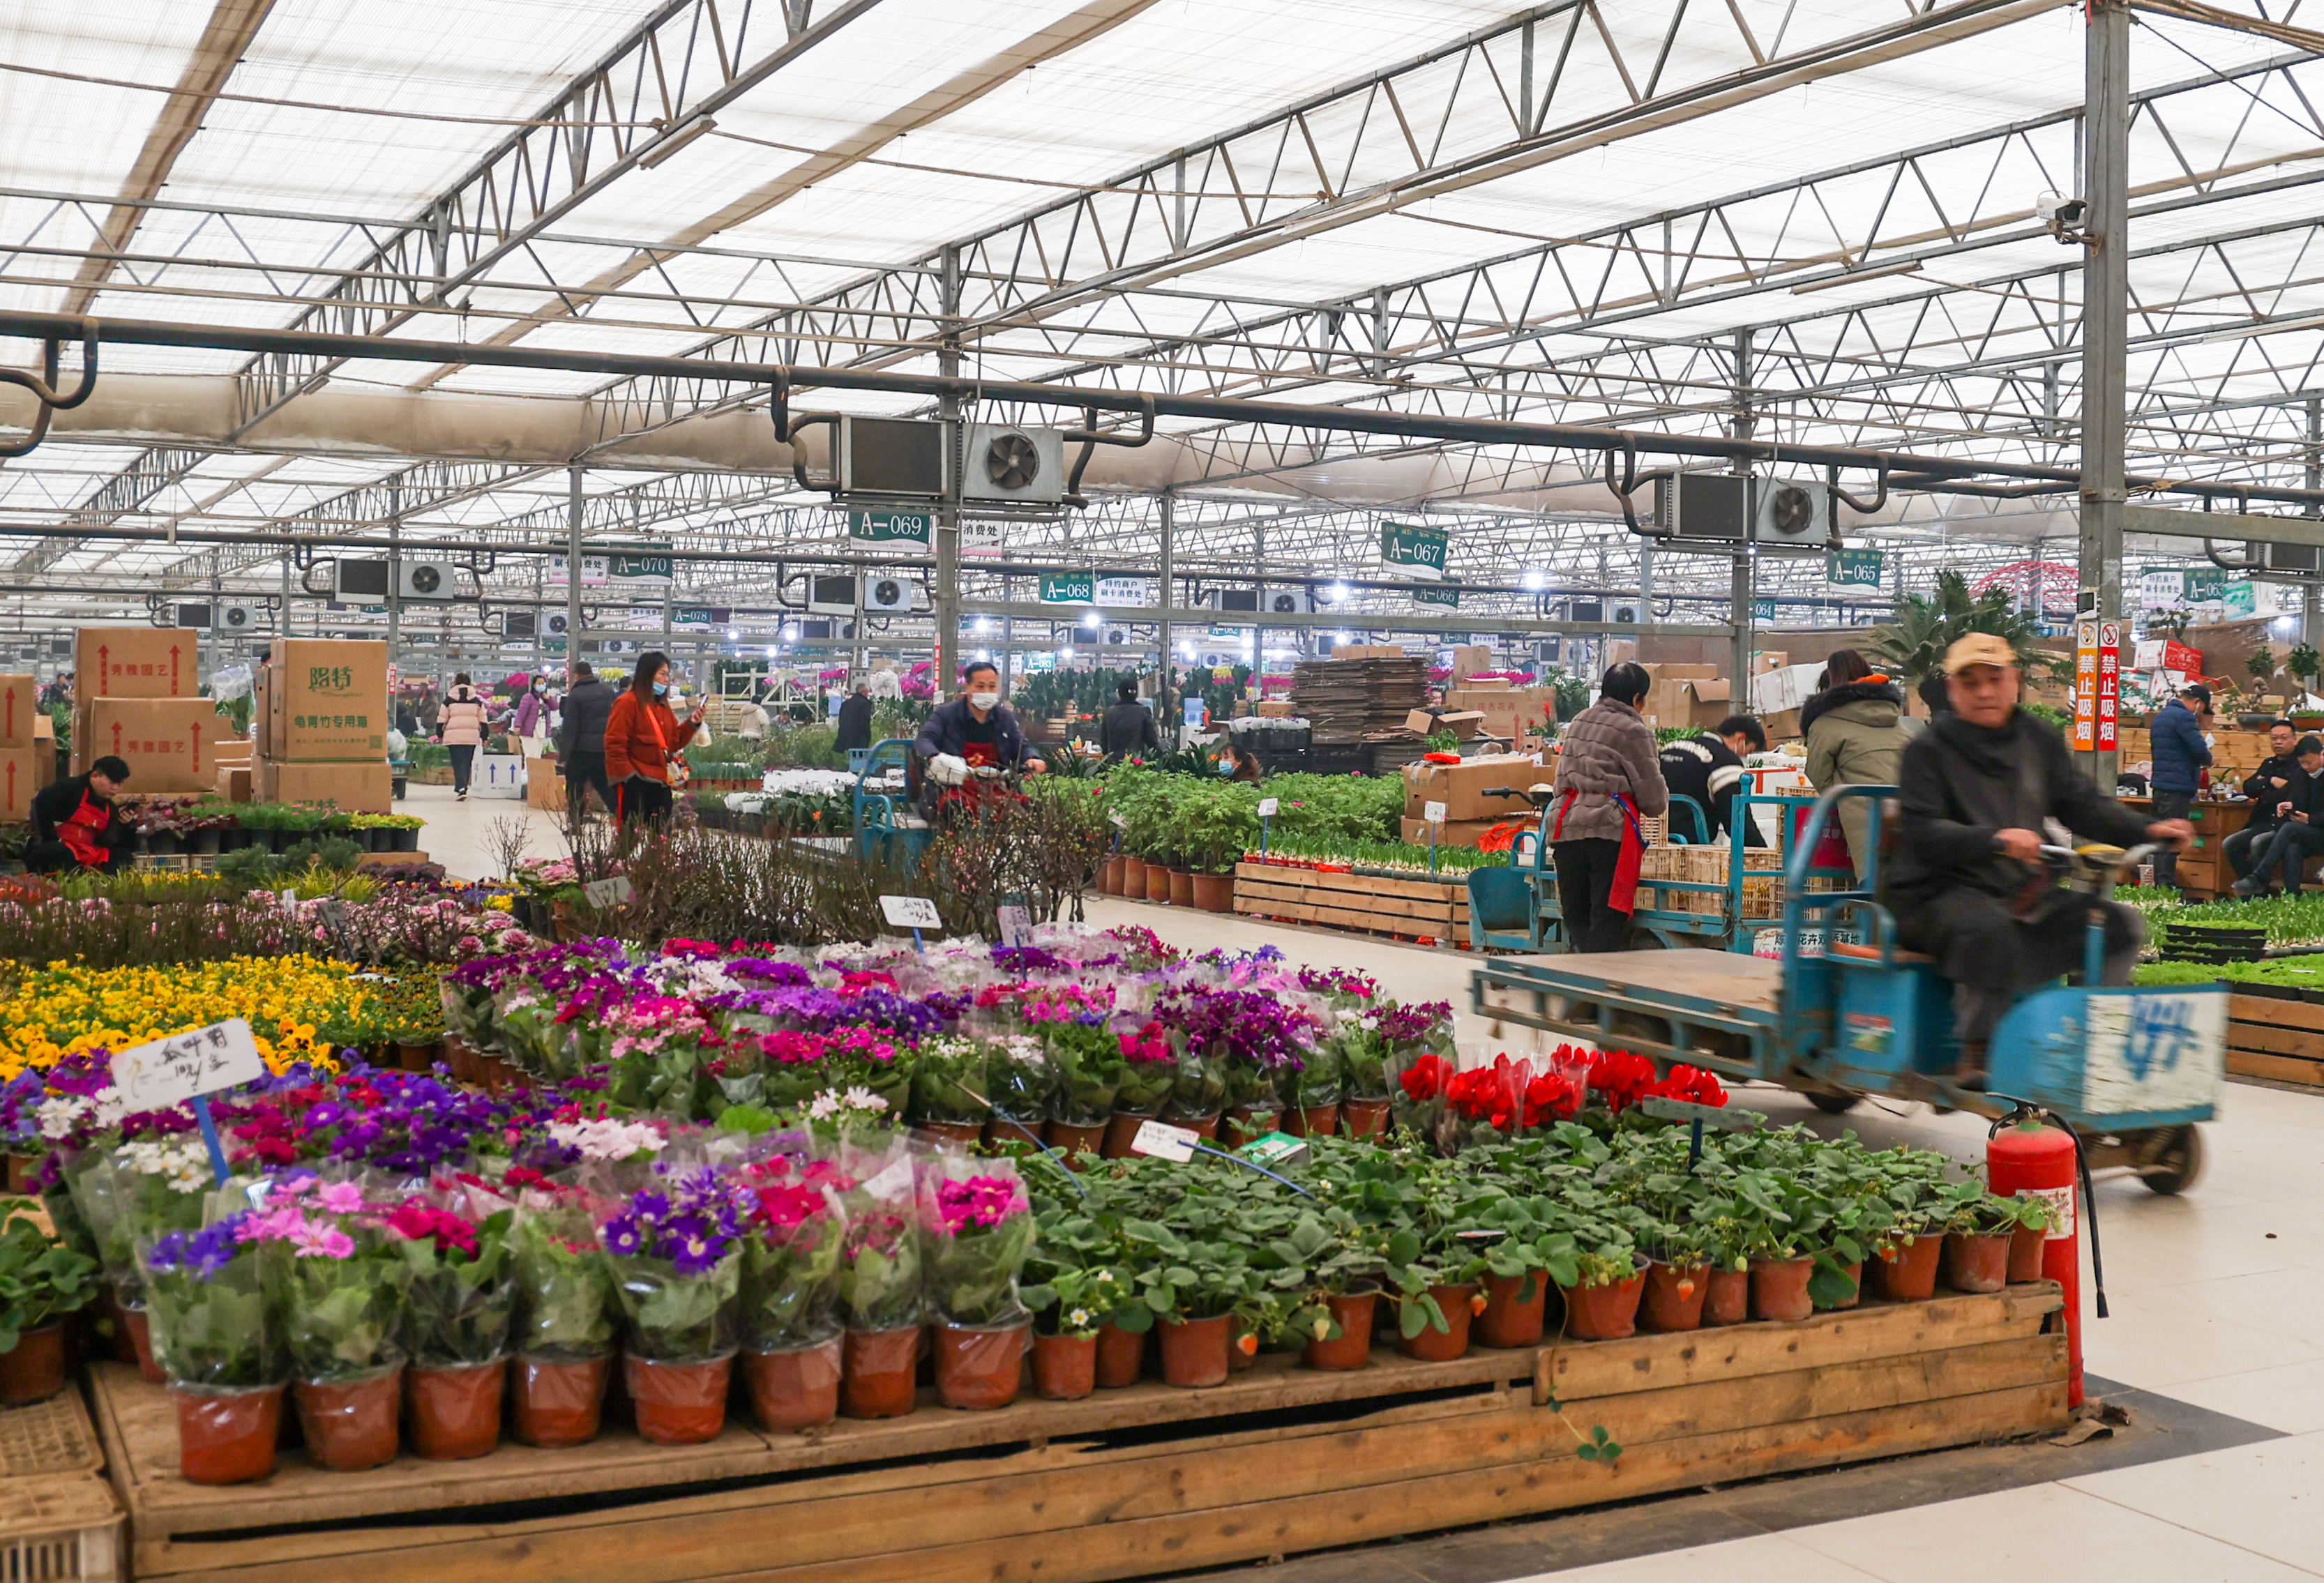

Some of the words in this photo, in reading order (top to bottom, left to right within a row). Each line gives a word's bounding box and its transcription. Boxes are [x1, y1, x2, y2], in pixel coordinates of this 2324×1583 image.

[860, 512, 922, 535] A-069
[1390, 537, 1440, 563] A-067
[617, 556, 667, 573] A-070
[1834, 561, 1876, 581] A-065
[1047, 581, 1089, 598] A-068
[1106, 579, 1138, 589] 特约商户
[1101, 589, 1142, 598] 刷卡消费处
[675, 609, 707, 621] A-078
[1027, 658, 1052, 669] A-083
[2076, 654, 2095, 741] 禁止吸烟
[2100, 654, 2116, 741] 禁止吸烟
[1775, 933, 1860, 945] 陈花卉双基地
